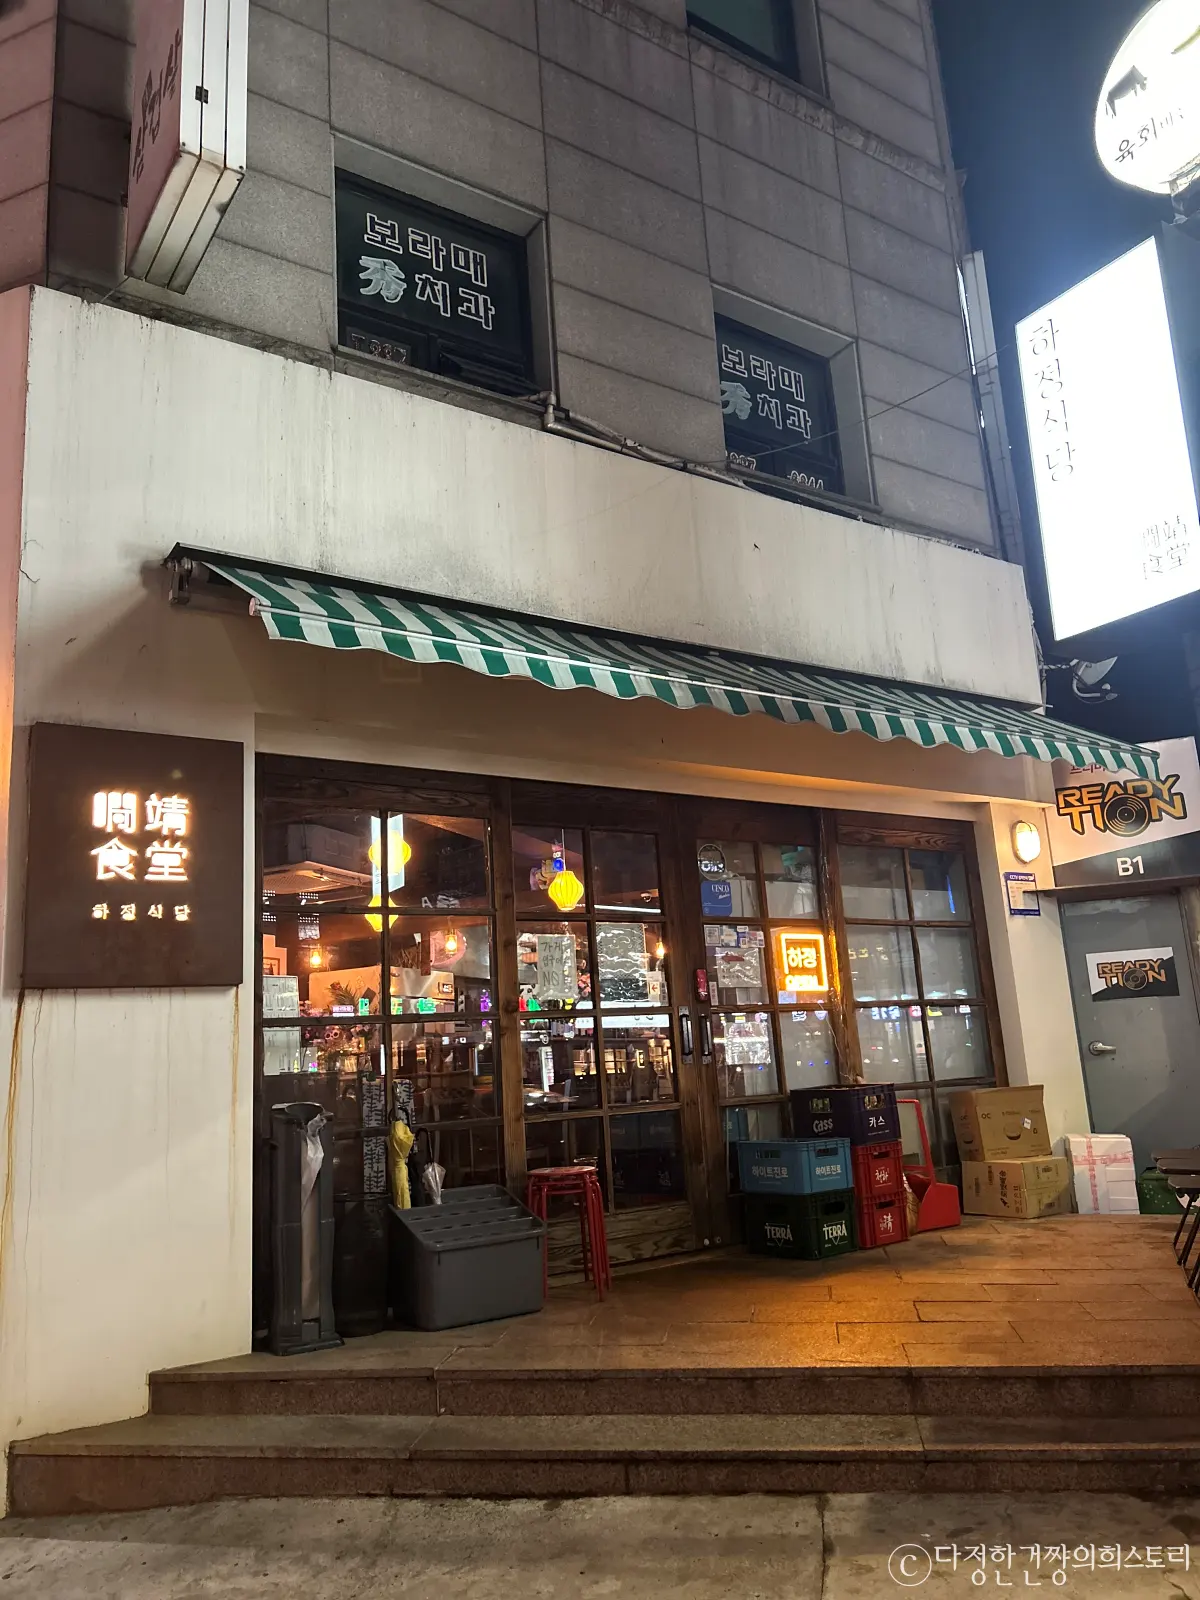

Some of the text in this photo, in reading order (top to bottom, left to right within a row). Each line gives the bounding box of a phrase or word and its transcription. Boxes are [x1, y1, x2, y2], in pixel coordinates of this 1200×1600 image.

[364, 212, 487, 287] 보라매
[722, 344, 805, 402] 보라매
[1029, 318, 1076, 482] 하정식당
[1056, 774, 1180, 808] READY
[1058, 792, 1187, 837] TION
[90, 836, 190, 881] 食堂
[1117, 855, 1145, 877] B1
[711, 884, 730, 893] CESCO
[91, 902, 192, 922] 하정식당
[786, 946, 818, 969] 하정
[1097, 957, 1164, 974] READY
[1099, 967, 1167, 991] TION
[812, 1118, 834, 1134] Cass
[868, 1116, 886, 1128] 카스
[751, 1165, 789, 1178] 하이트진로
[815, 1164, 842, 1176] 하이트진로
[764, 1222, 794, 1241] TERRA
[822, 1220, 848, 1240] TERRA
